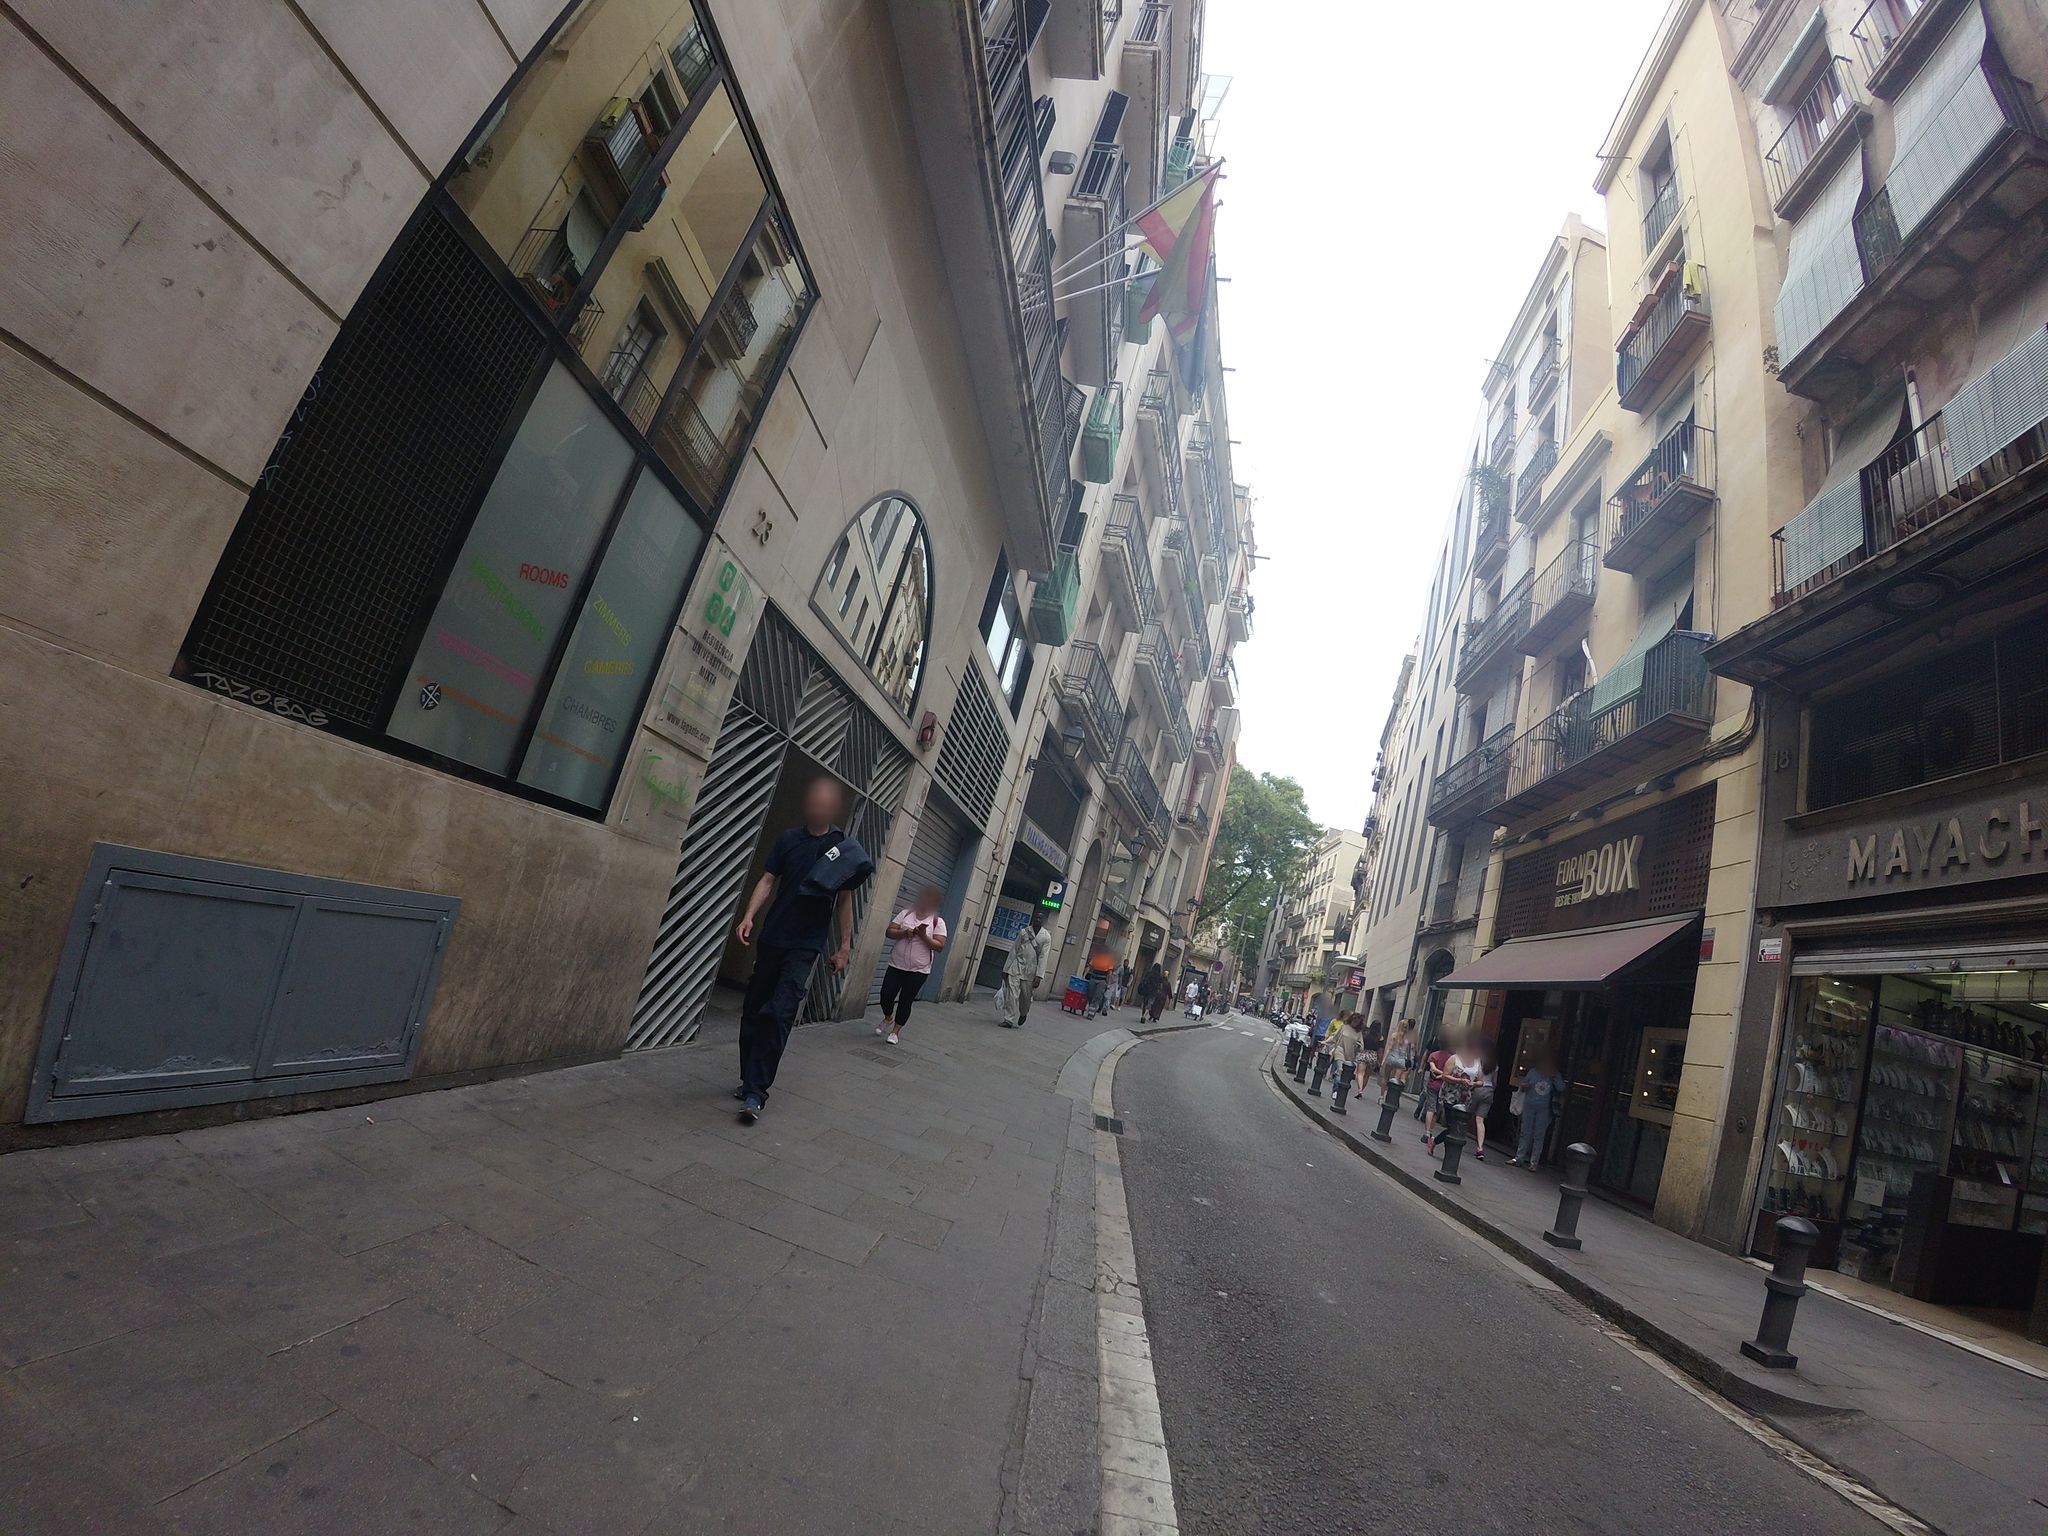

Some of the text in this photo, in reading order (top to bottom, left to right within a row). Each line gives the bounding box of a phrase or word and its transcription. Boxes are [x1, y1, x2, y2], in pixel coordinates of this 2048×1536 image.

[752, 510, 773, 545] 23
[519, 562, 569, 589] ROOMS
[563, 696, 617, 733] CHAMBRES
[1772, 749, 1790, 772] 18
[1556, 834, 1643, 900] FORN BOIX
[1047, 880, 1063, 898] P
